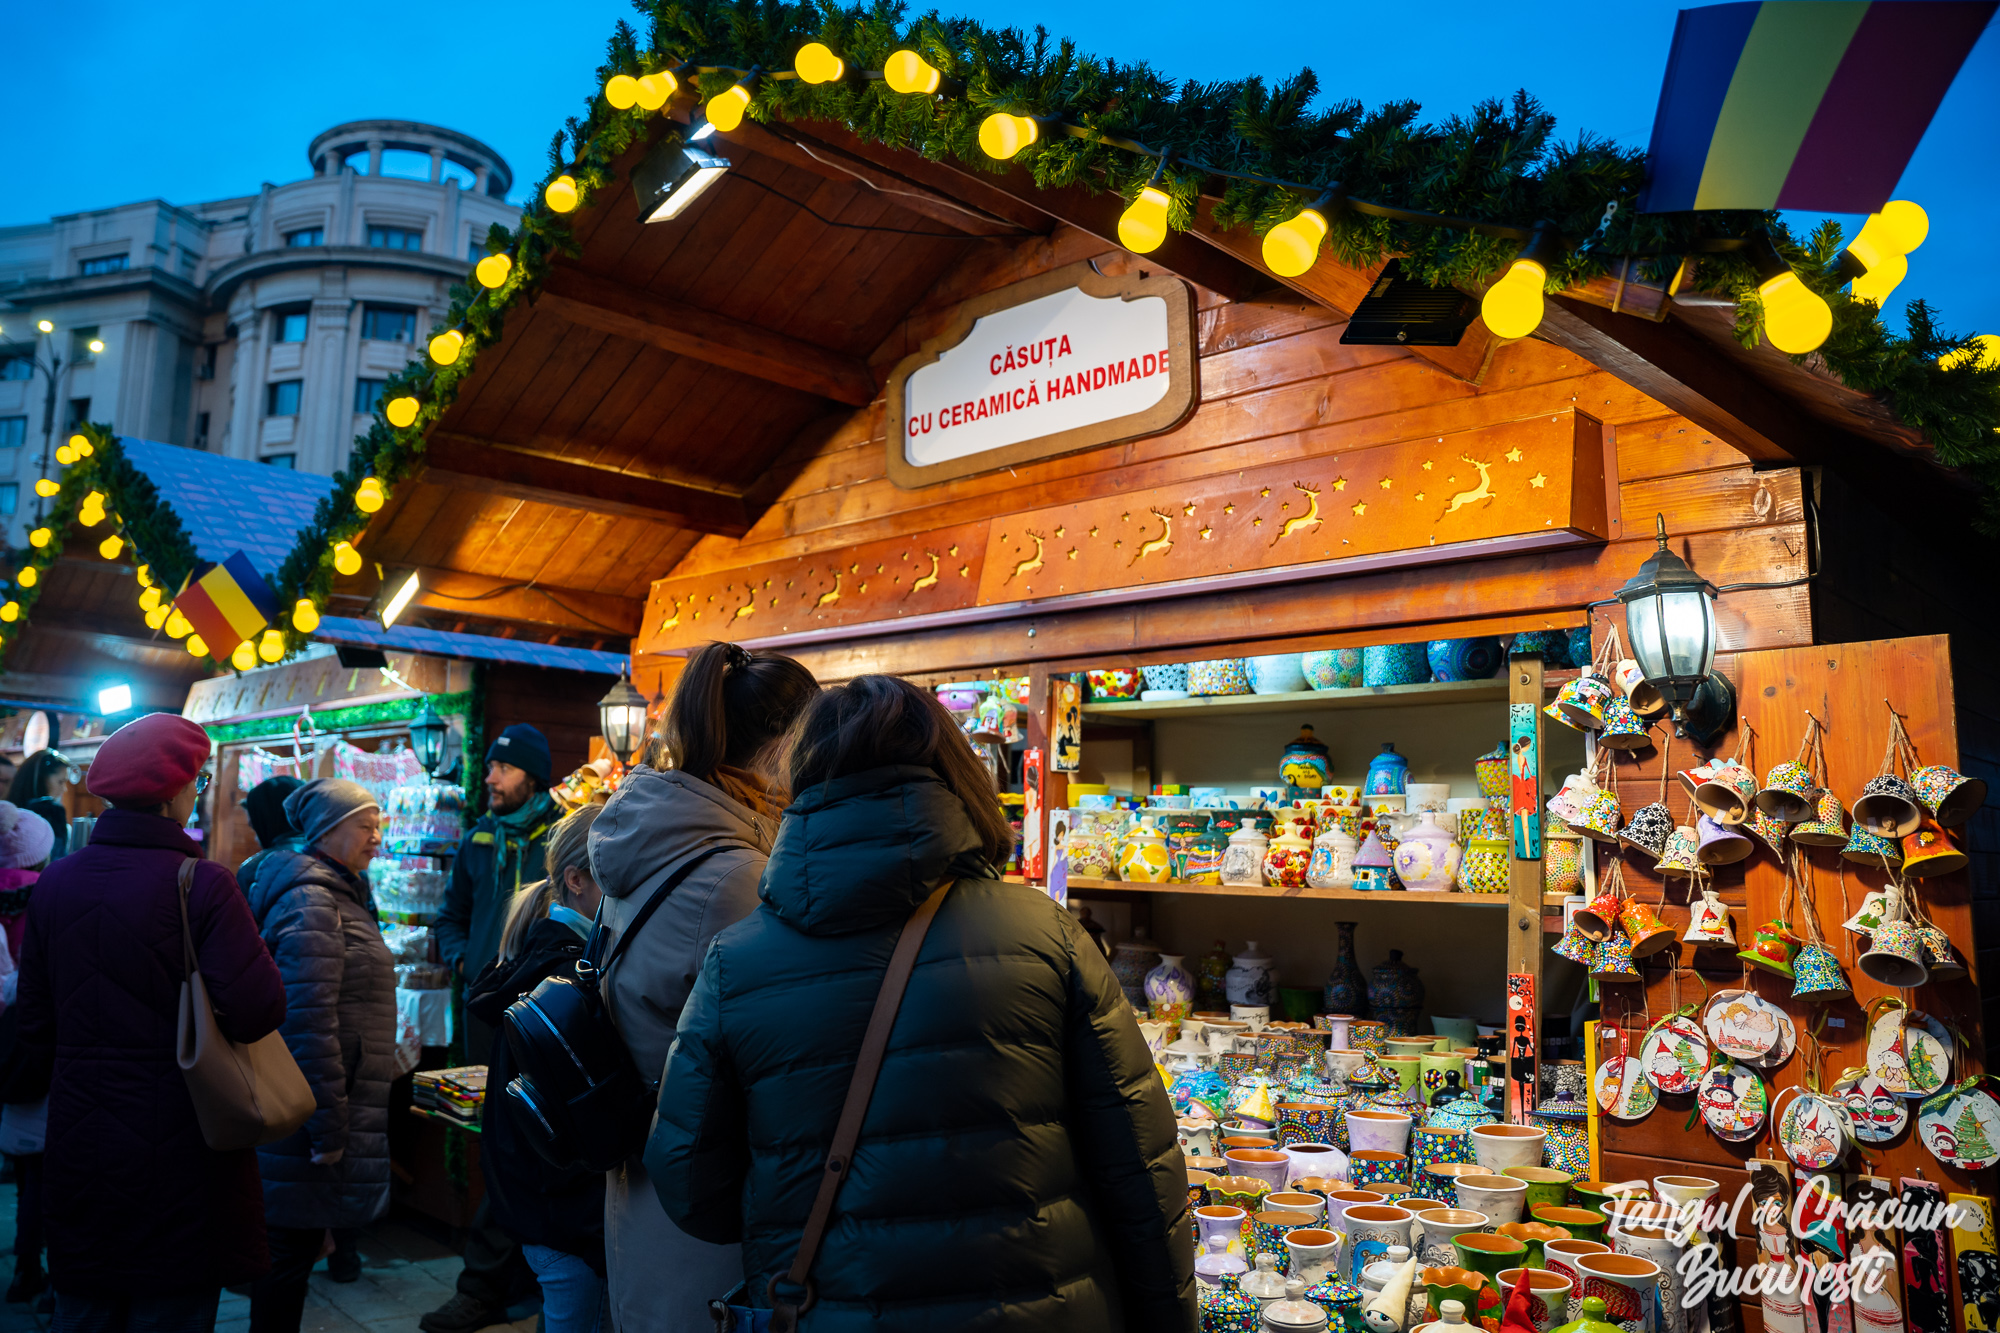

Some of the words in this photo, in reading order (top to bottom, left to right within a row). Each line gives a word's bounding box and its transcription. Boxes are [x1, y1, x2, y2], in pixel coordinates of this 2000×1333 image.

[908, 412, 932, 438] CU
[938, 379, 1040, 430] CERAMICĂ
[1046, 349, 1170, 402] HANDMADE
